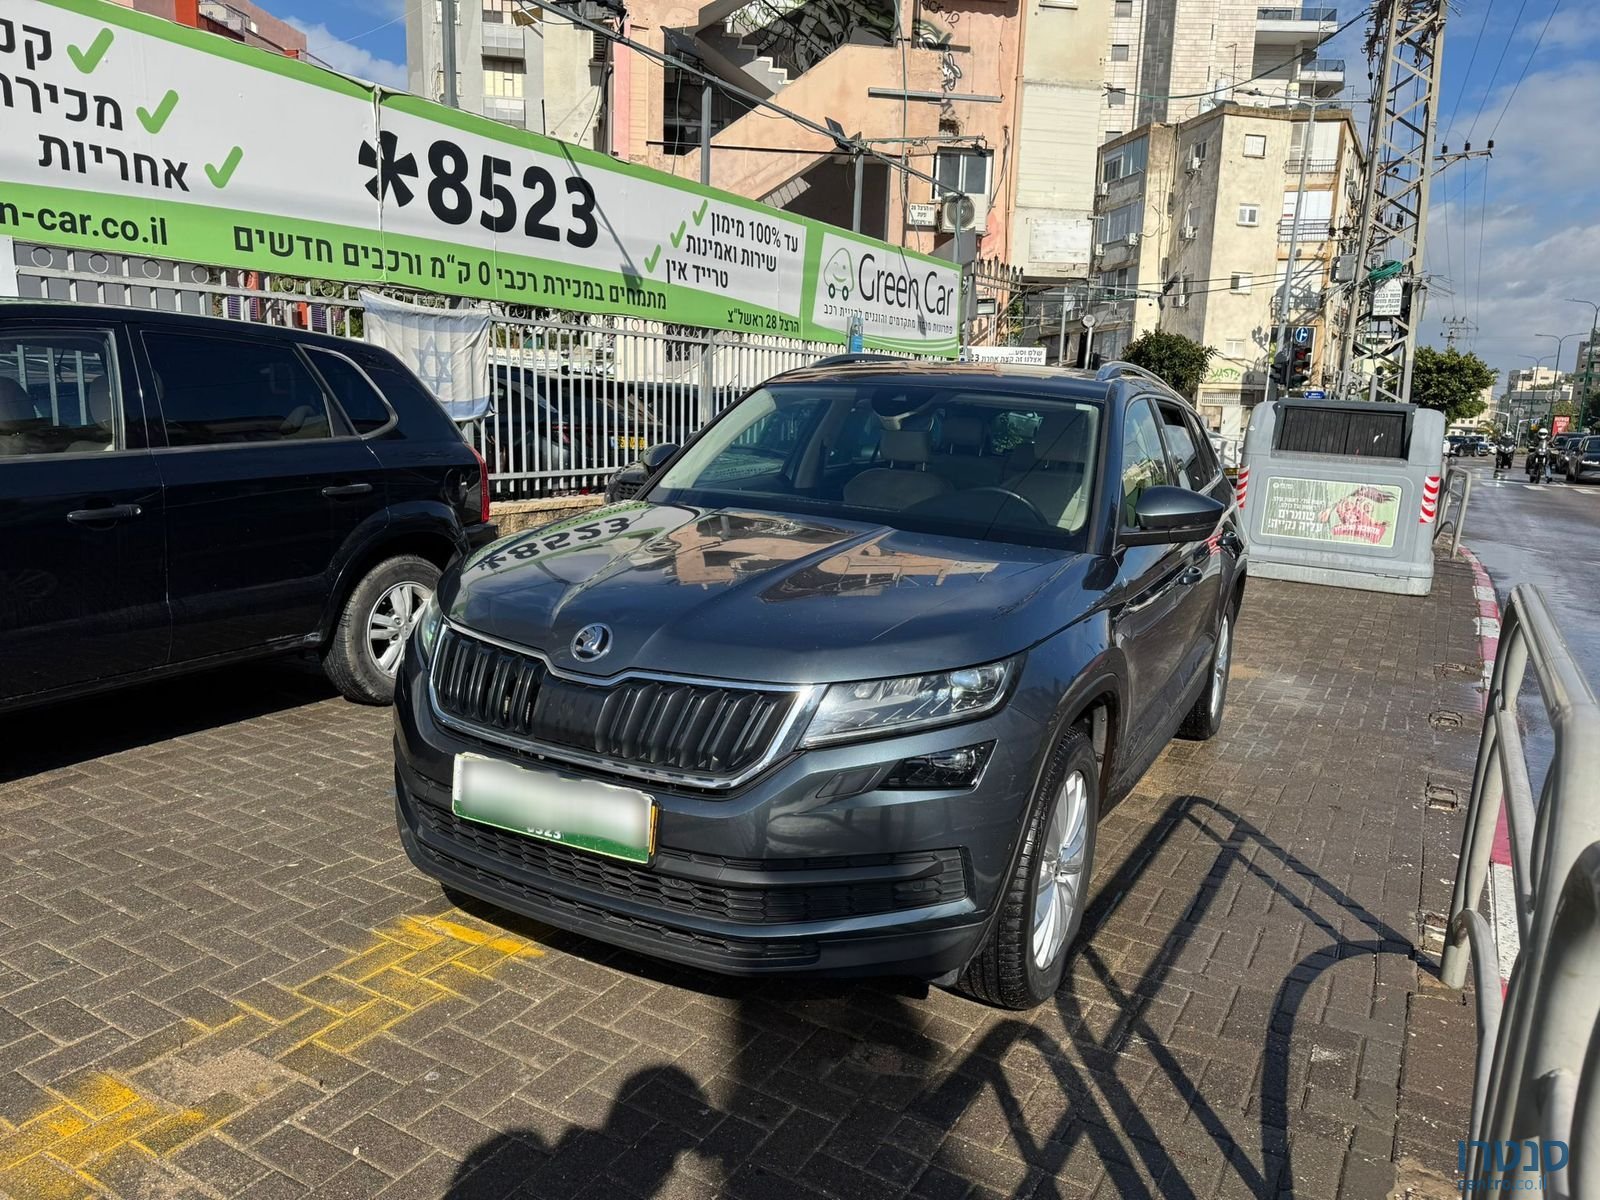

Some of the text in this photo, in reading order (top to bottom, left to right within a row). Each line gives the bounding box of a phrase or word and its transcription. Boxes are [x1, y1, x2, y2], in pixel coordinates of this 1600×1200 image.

[38, 134, 190, 192] אחריות
[234, 225, 333, 263] חדשים
[711, 212, 799, 252] עד 100% מימון
[343, 243, 422, 275] ורכבים
[686, 234, 777, 273] שירות ואמינות
[497, 267, 538, 292] רכבי
[543, 274, 605, 302] במכירת
[666, 258, 728, 288] טרייד אין
[858, 254, 954, 316] Green Car
[610, 284, 667, 310] מתמחים
[824, 304, 837, 316] רכב
[766, 314, 777, 329] 28
[779, 315, 799, 333] הרצל
